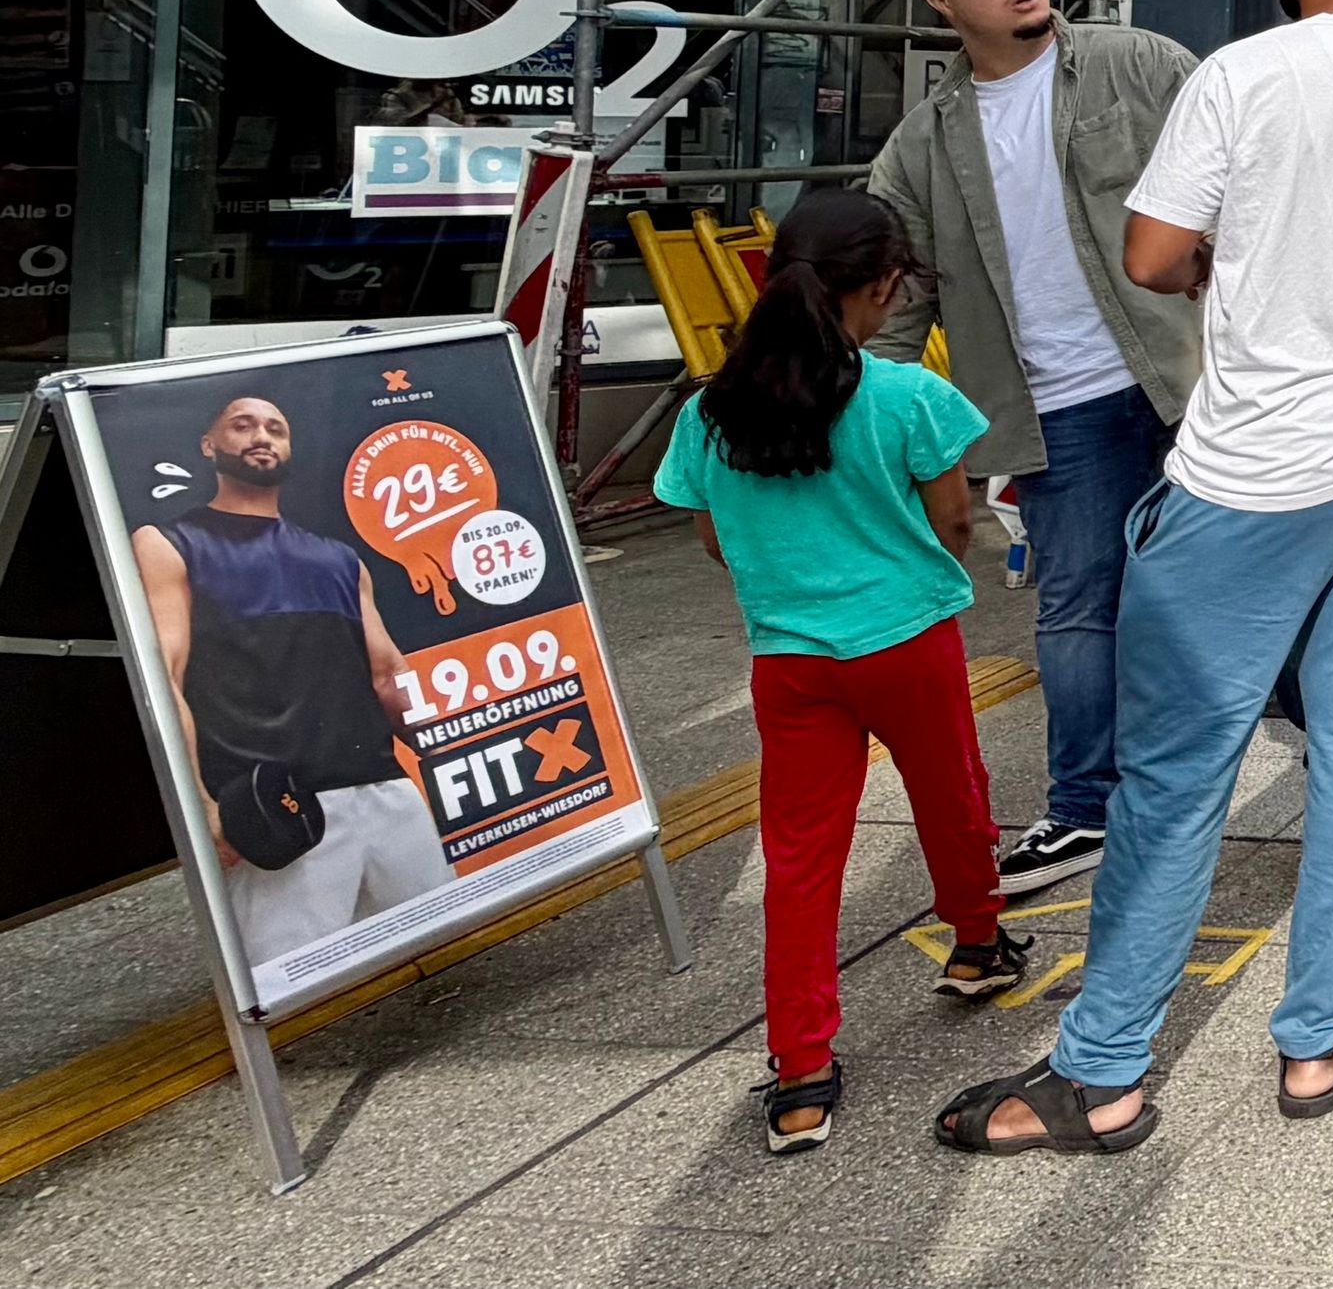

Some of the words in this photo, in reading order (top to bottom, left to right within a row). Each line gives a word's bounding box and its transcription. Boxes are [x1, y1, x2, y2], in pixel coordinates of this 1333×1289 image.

[371, 396, 391, 408] FOR
[392, 394, 408, 405] ALL
[409, 392, 421, 402] OF
[421, 390, 434, 400] US
[351, 456, 372, 499] ALLES
[365, 431, 400, 457] DRIN
[401, 424, 429, 440] FÜR
[431, 429, 462, 453] MTL.
[461, 448, 484, 477] NUR
[461, 531, 483, 544] BIS
[486, 520, 525, 538] 20.09.
[394, 629, 577, 726] 19.09.
[415, 679, 580, 749] NEUERÖFFNUNG
[449, 782, 608, 859] LEVERKUSEN-WIESDORF
